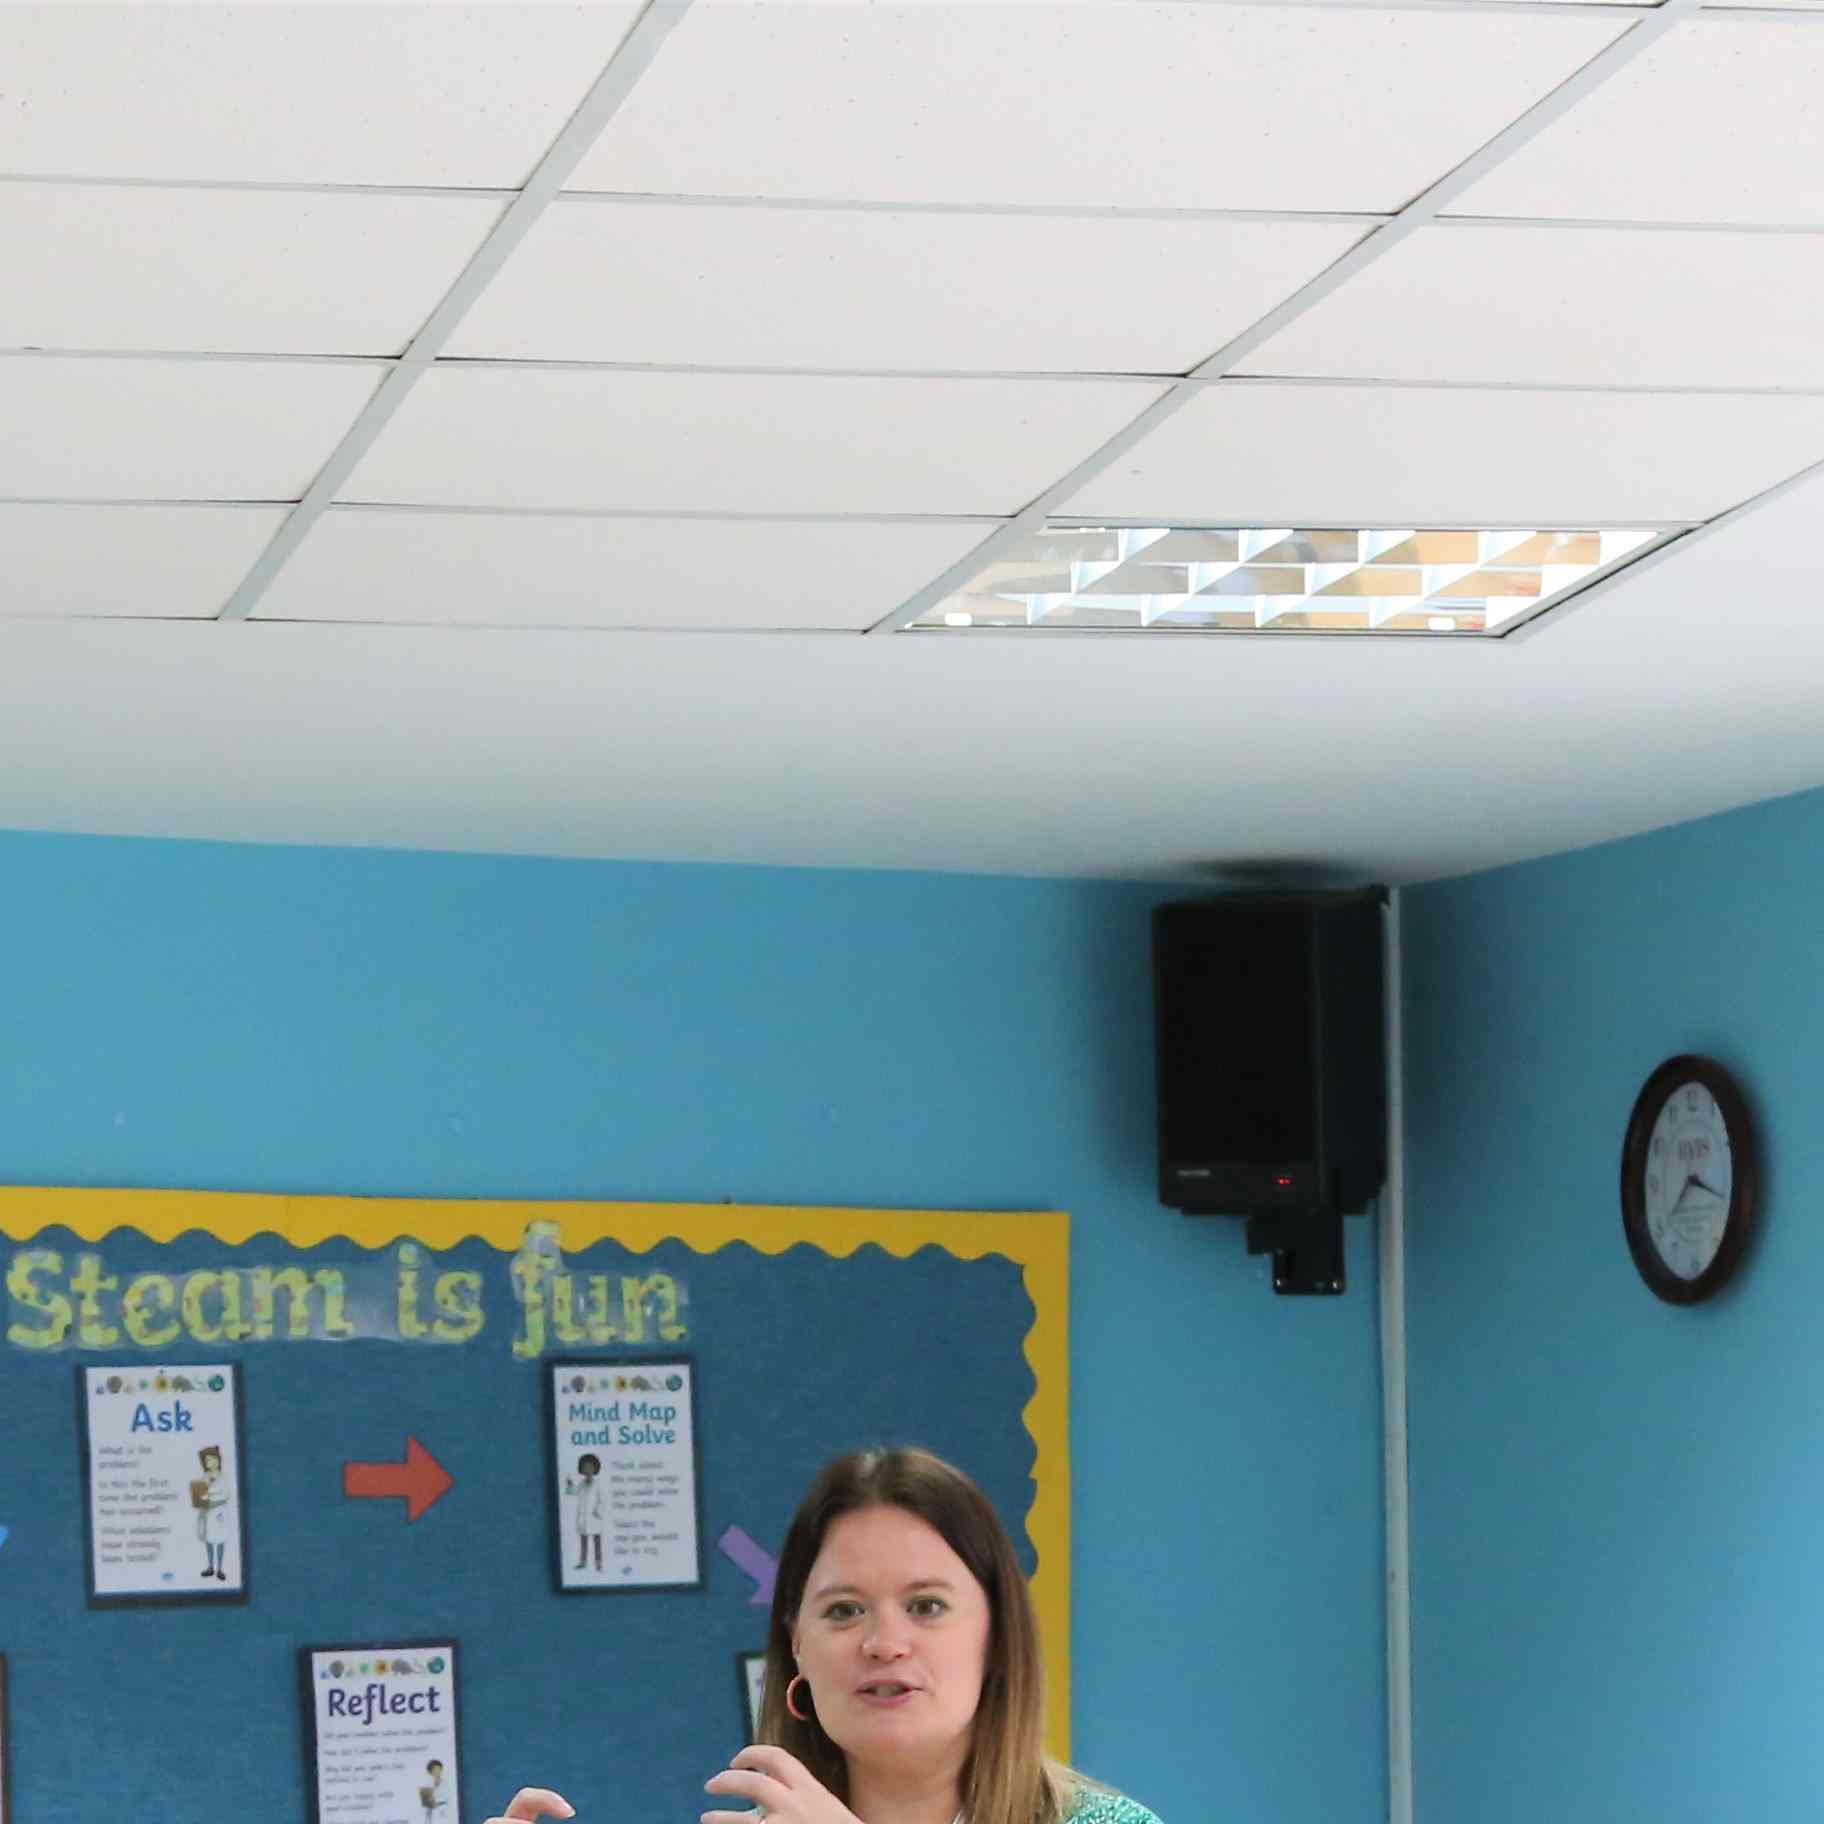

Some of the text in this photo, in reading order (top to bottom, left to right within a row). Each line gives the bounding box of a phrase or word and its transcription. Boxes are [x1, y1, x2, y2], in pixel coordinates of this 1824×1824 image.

[6, 1220, 687, 1358] Steam is fun
[131, 1400, 193, 1432] Ask
[569, 1401, 676, 1424] Mind Map
[571, 1424, 675, 1445] and Solve
[328, 1683, 440, 1725] Reflect
